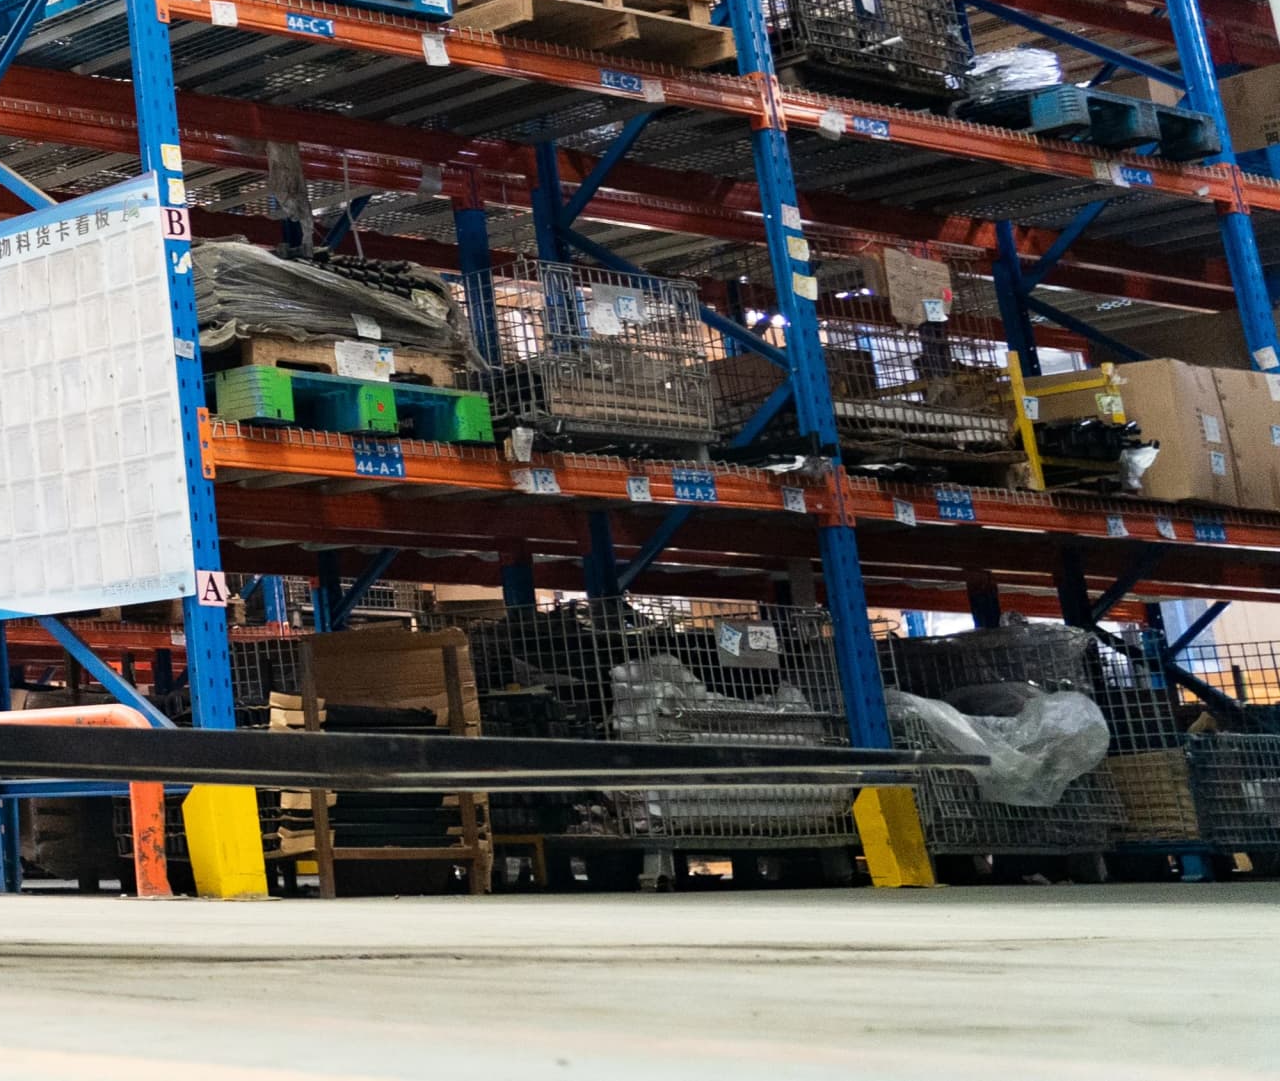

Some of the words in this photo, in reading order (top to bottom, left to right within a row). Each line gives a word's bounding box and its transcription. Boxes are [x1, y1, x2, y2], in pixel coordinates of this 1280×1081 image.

[288, 17, 334, 35] 44-C-1
[601, 71, 640, 90] 44-C-2
[166, 209, 185, 236] B
[357, 461, 404, 477] 44-A-1
[676, 487, 717, 501] 44-A-2
[202, 572, 225, 602] A
